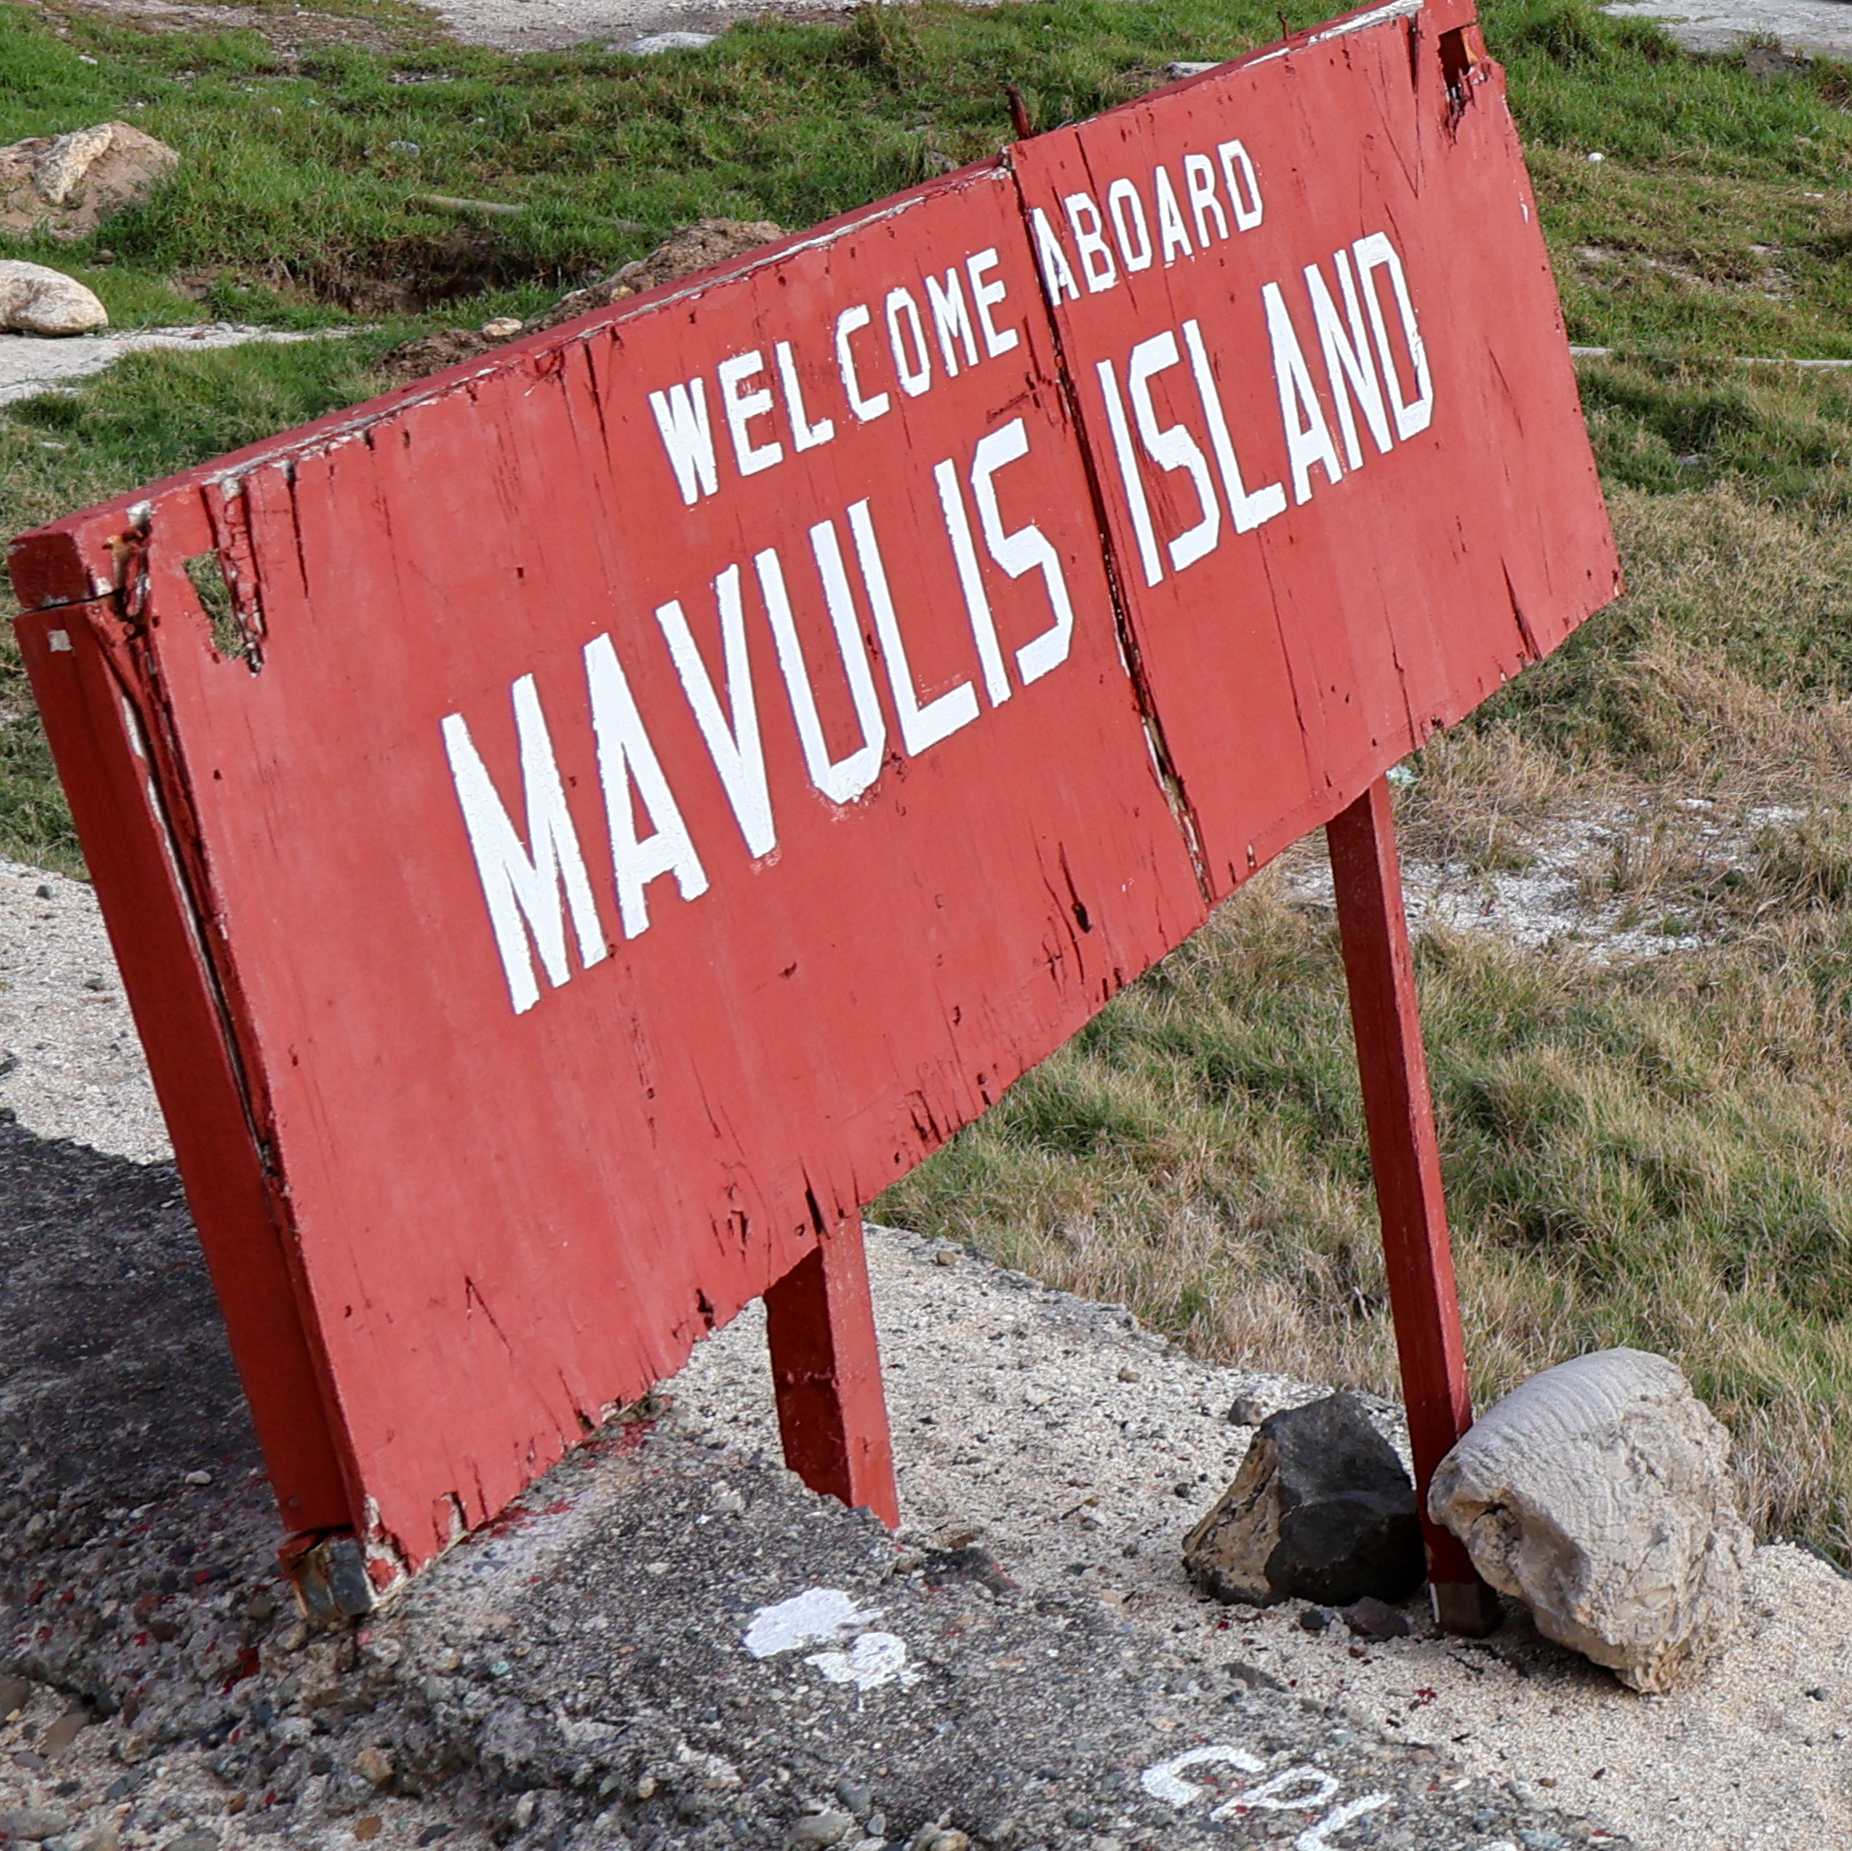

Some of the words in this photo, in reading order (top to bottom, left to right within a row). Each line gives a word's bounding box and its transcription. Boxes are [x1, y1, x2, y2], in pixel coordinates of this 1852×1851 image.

[649, 248, 1018, 505] WELCOME
[1033, 139, 1263, 308] ABOARD
[442, 418, 1073, 1015] MAVULIS
[1097, 231, 1434, 587] ISLAND
